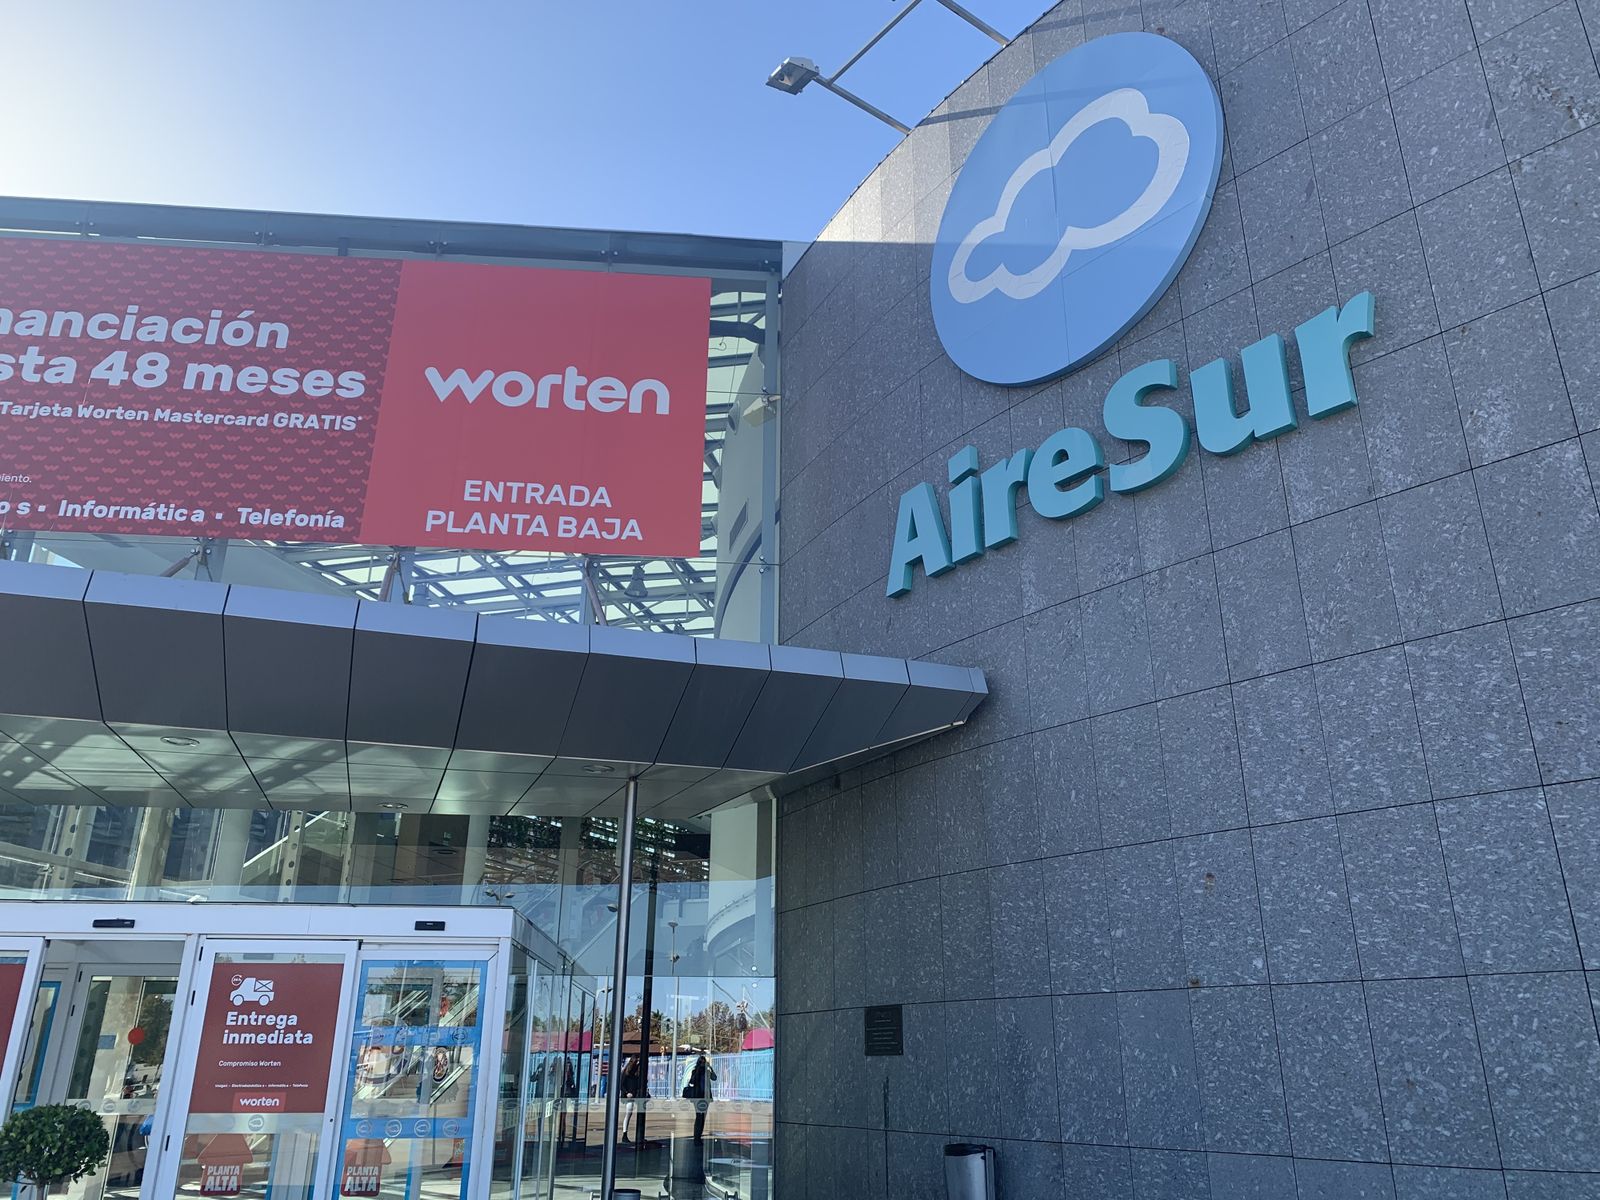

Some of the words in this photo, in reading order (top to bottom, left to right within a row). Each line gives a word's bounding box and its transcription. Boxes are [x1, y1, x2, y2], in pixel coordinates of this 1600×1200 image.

[89, 350, 170, 388] 48
[183, 362, 367, 399] meses
[424, 365, 670, 415] worten
[0, 401, 73, 419] Tarjeta
[77, 404, 149, 421] Worten
[153, 408, 269, 427] Mastercard
[885, 290, 1376, 599] AireSur
[0, 473, 32, 484] iento.
[463, 479, 612, 508] ENTRADA
[237, 507, 345, 528] Telefonía
[425, 510, 549, 537] PLANTA
[557, 516, 643, 541] BAJA
[226, 1011, 298, 1029] Entrega
[222, 1029, 313, 1044] inmediata
[239, 1096, 280, 1106] worten
[207, 1165, 240, 1176] PLANTA
[346, 1166, 379, 1176] PLANTA
[204, 1175, 238, 1191] ALTA
[344, 1176, 378, 1192] ALTA
